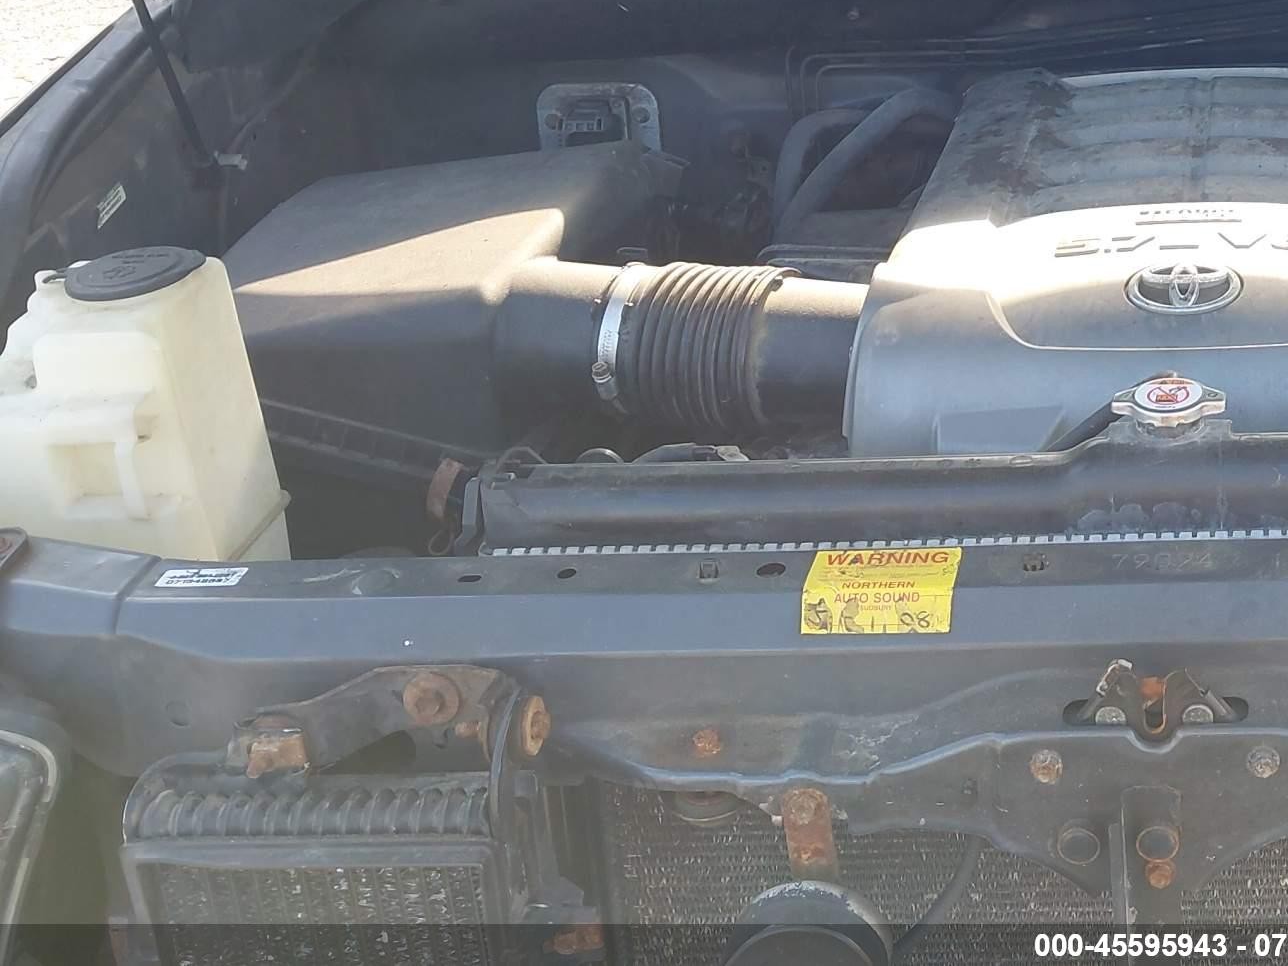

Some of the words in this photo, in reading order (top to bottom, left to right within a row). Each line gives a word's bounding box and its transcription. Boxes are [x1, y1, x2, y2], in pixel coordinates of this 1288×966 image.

[827, 551, 950, 566] WARNING
[841, 581, 916, 590] NORTHERN
[834, 592, 869, 604] AUTO
[873, 591, 920, 603] SOUND
